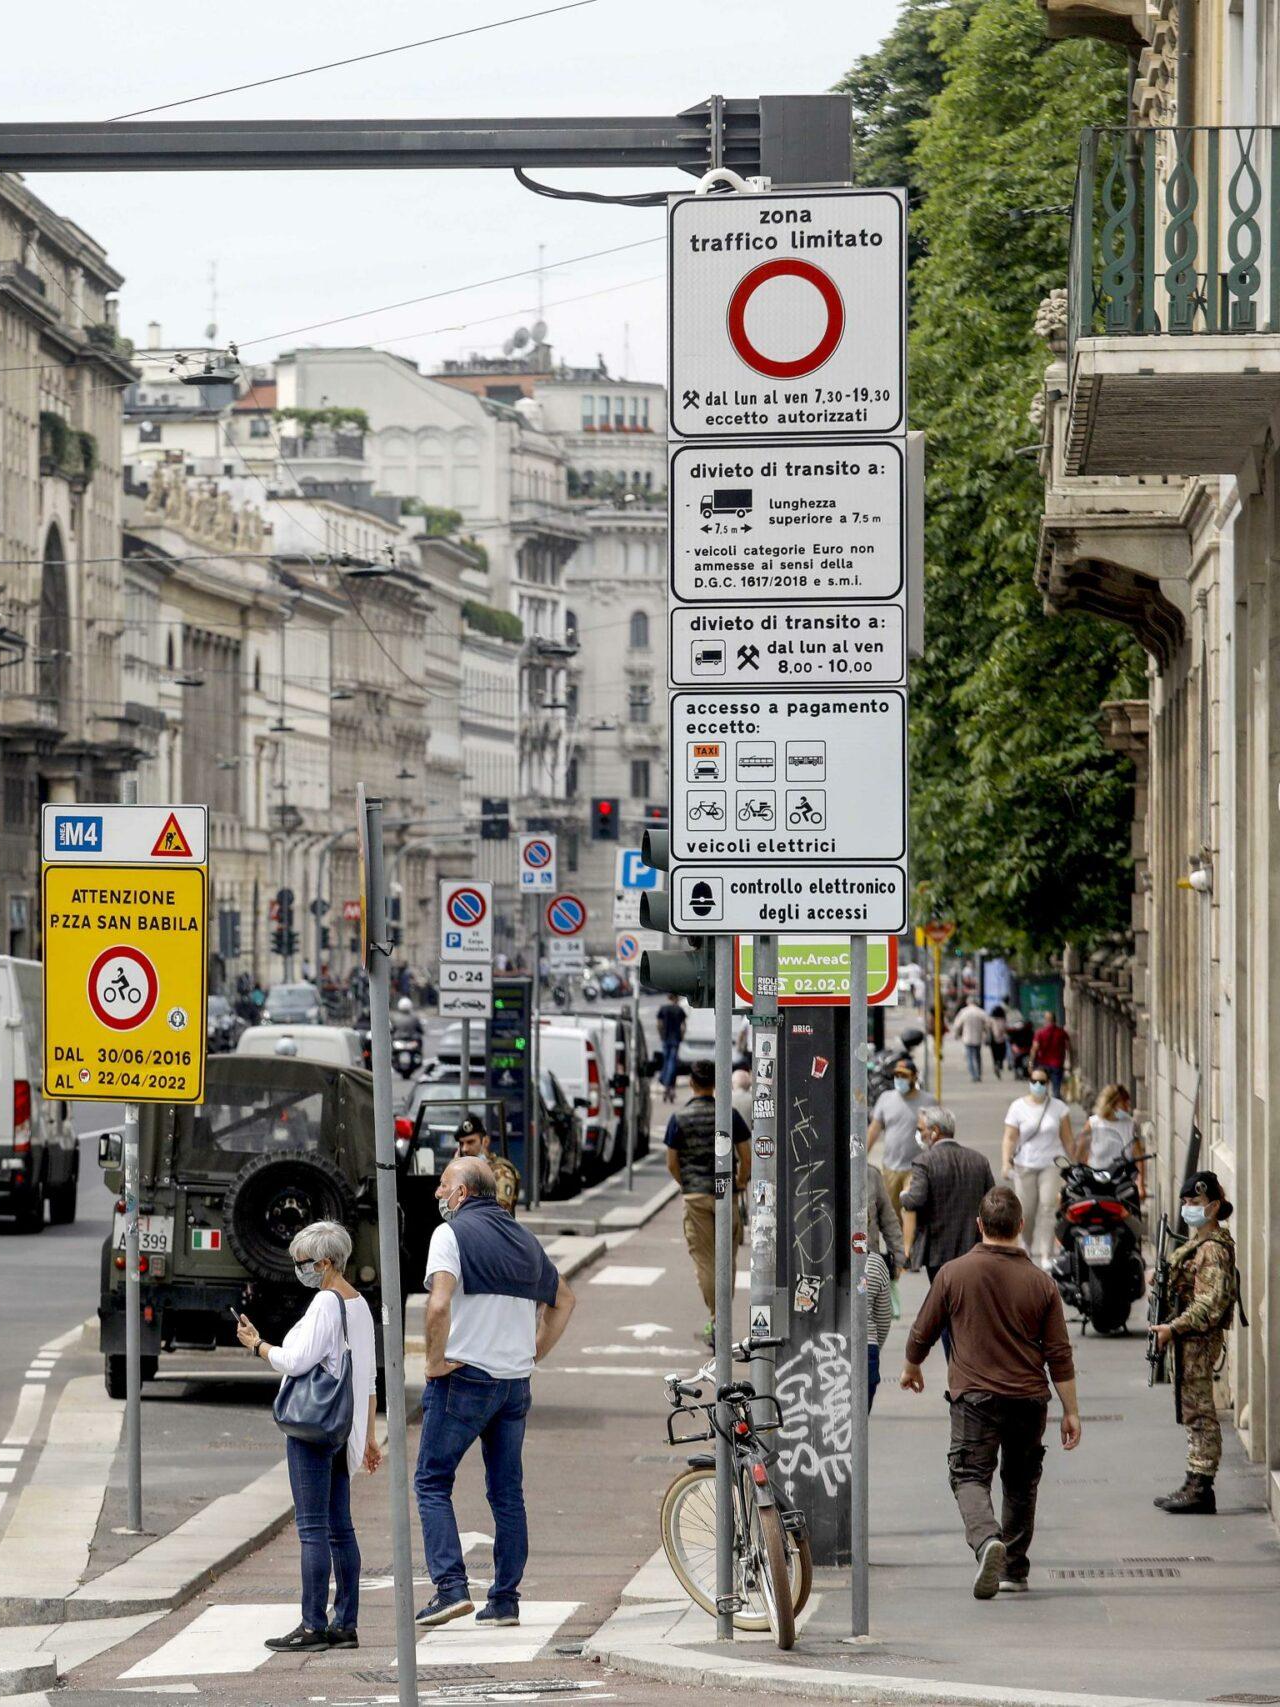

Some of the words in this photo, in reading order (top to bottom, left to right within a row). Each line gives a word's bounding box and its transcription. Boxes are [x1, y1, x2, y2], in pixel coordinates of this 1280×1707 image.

[759, 209, 812, 224] zona
[690, 232, 778, 252] traffico
[790, 229, 883, 249] limitato
[705, 390, 727, 406] dal
[734, 390, 757, 405] lun
[764, 390, 778, 405] al
[784, 392, 808, 404] ven
[705, 411, 768, 426] eccetto
[777, 408, 867, 424] autorizzati
[690, 463, 754, 479] divieto
[760, 462, 777, 477] di
[785, 461, 861, 477] transito
[868, 463, 886, 475] a:
[769, 498, 836, 511] lunghezza
[768, 514, 833, 527] superiore
[839, 515, 847, 524] a
[731, 526, 738, 534] m
[694, 545, 737, 557] veicoli
[743, 544, 806, 558] categorie
[813, 543, 844, 555] Euro
[850, 545, 875, 554] non
[694, 562, 755, 572] ammesse
[761, 560, 773, 571] ai
[780, 559, 814, 570] sensi
[820, 558, 853, 570] della
[694, 577, 737, 589] D.G.C.
[740, 576, 807, 588] 1617/2018
[813, 578, 821, 587] e
[827, 575, 862, 587] s.m.i.
[690, 616, 754, 631] divieto
[760, 615, 777, 630] di
[785, 613, 861, 630] transito
[868, 617, 886, 629] a:
[767, 641, 794, 655] dal
[800, 640, 826, 654] lun
[832, 640, 848, 653] al
[854, 641, 884, 653] ven
[686, 702, 761, 715] accesso
[768, 704, 778, 714] a
[787, 699, 890, 717] pagamento
[686, 722, 761, 734] eccetto:
[696, 746, 719, 756] TAXI
[66, 822, 98, 846] M4
[686, 838, 751, 853] veicoli
[756, 838, 836, 853] elettrici
[730, 878, 802, 895] controllo
[809, 877, 896, 894] elettronico
[71, 888, 176, 905] ATTENZIONE
[759, 904, 800, 924] degli
[807, 903, 868, 920] accessi
[50, 914, 91, 929] P.ZZA
[97, 915, 131, 930] SAN
[138, 915, 199, 931] BABILA
[794, 979, 850, 991] 02.02.0
[54, 1047, 84, 1062] DAL
[97, 1048, 191, 1066] 30/06/2016
[55, 1075, 74, 1089] AL
[98, 1071, 186, 1090] 22/04/2022
[142, 1234, 167, 1250] 399
